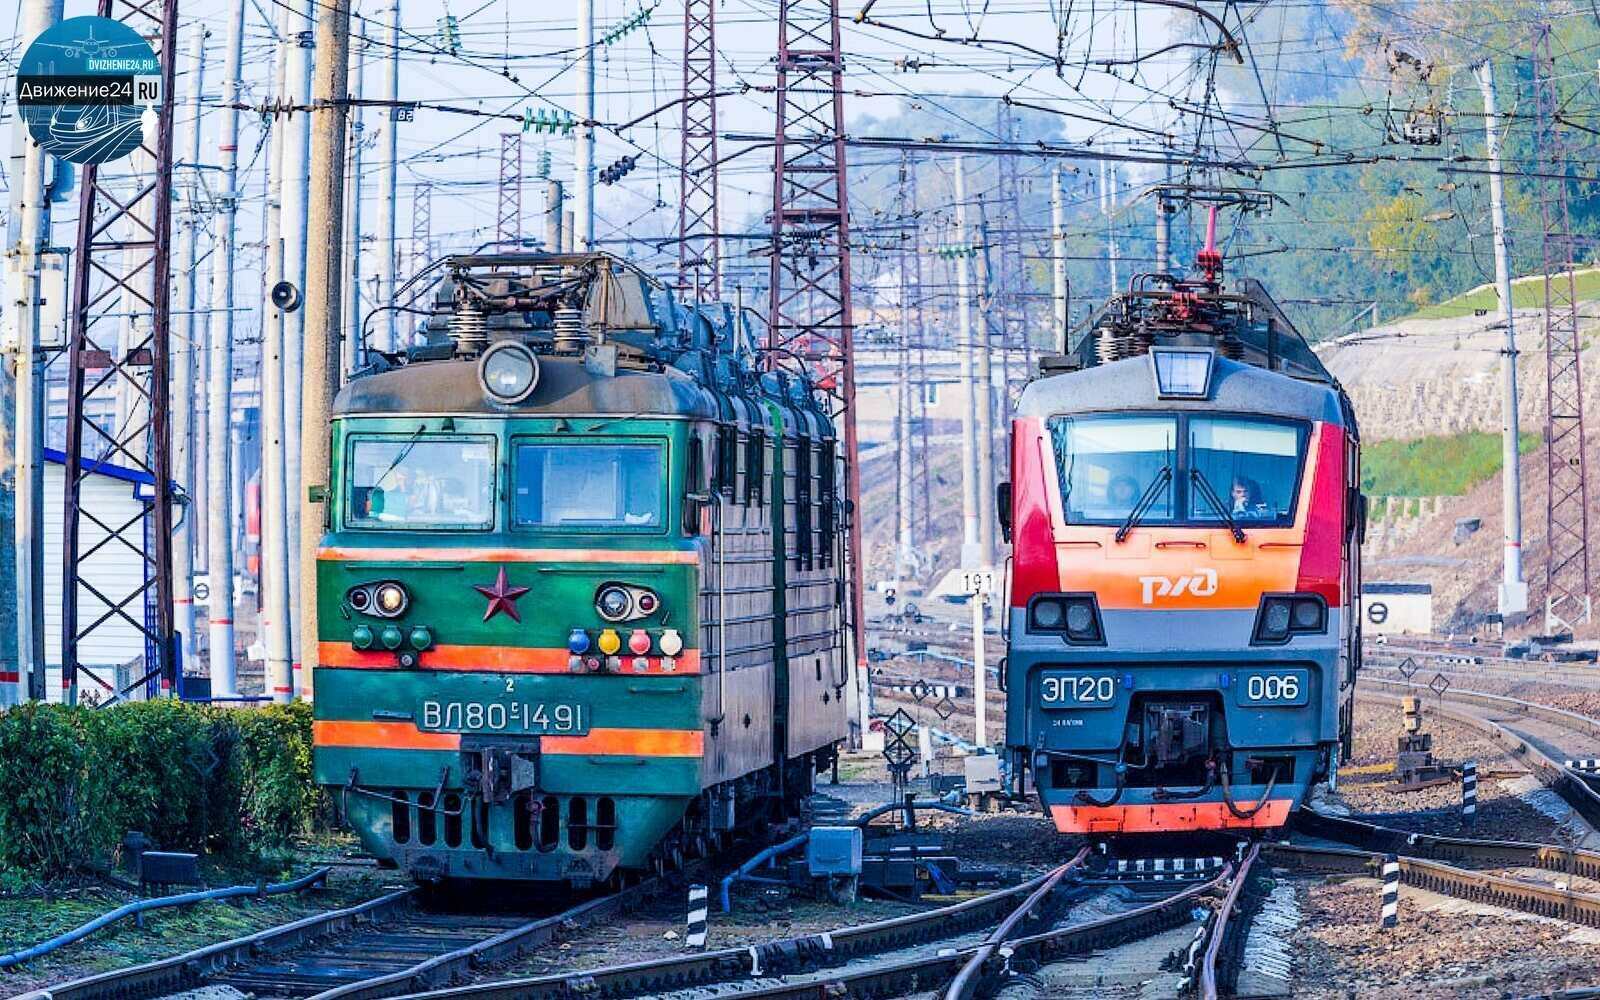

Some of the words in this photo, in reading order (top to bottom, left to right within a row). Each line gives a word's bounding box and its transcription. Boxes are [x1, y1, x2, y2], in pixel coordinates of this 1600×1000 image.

[964, 573, 992, 592] 191
[505, 678, 514, 692] 2
[1042, 676, 1114, 702] ЭП20
[1248, 675, 1299, 700] 006
